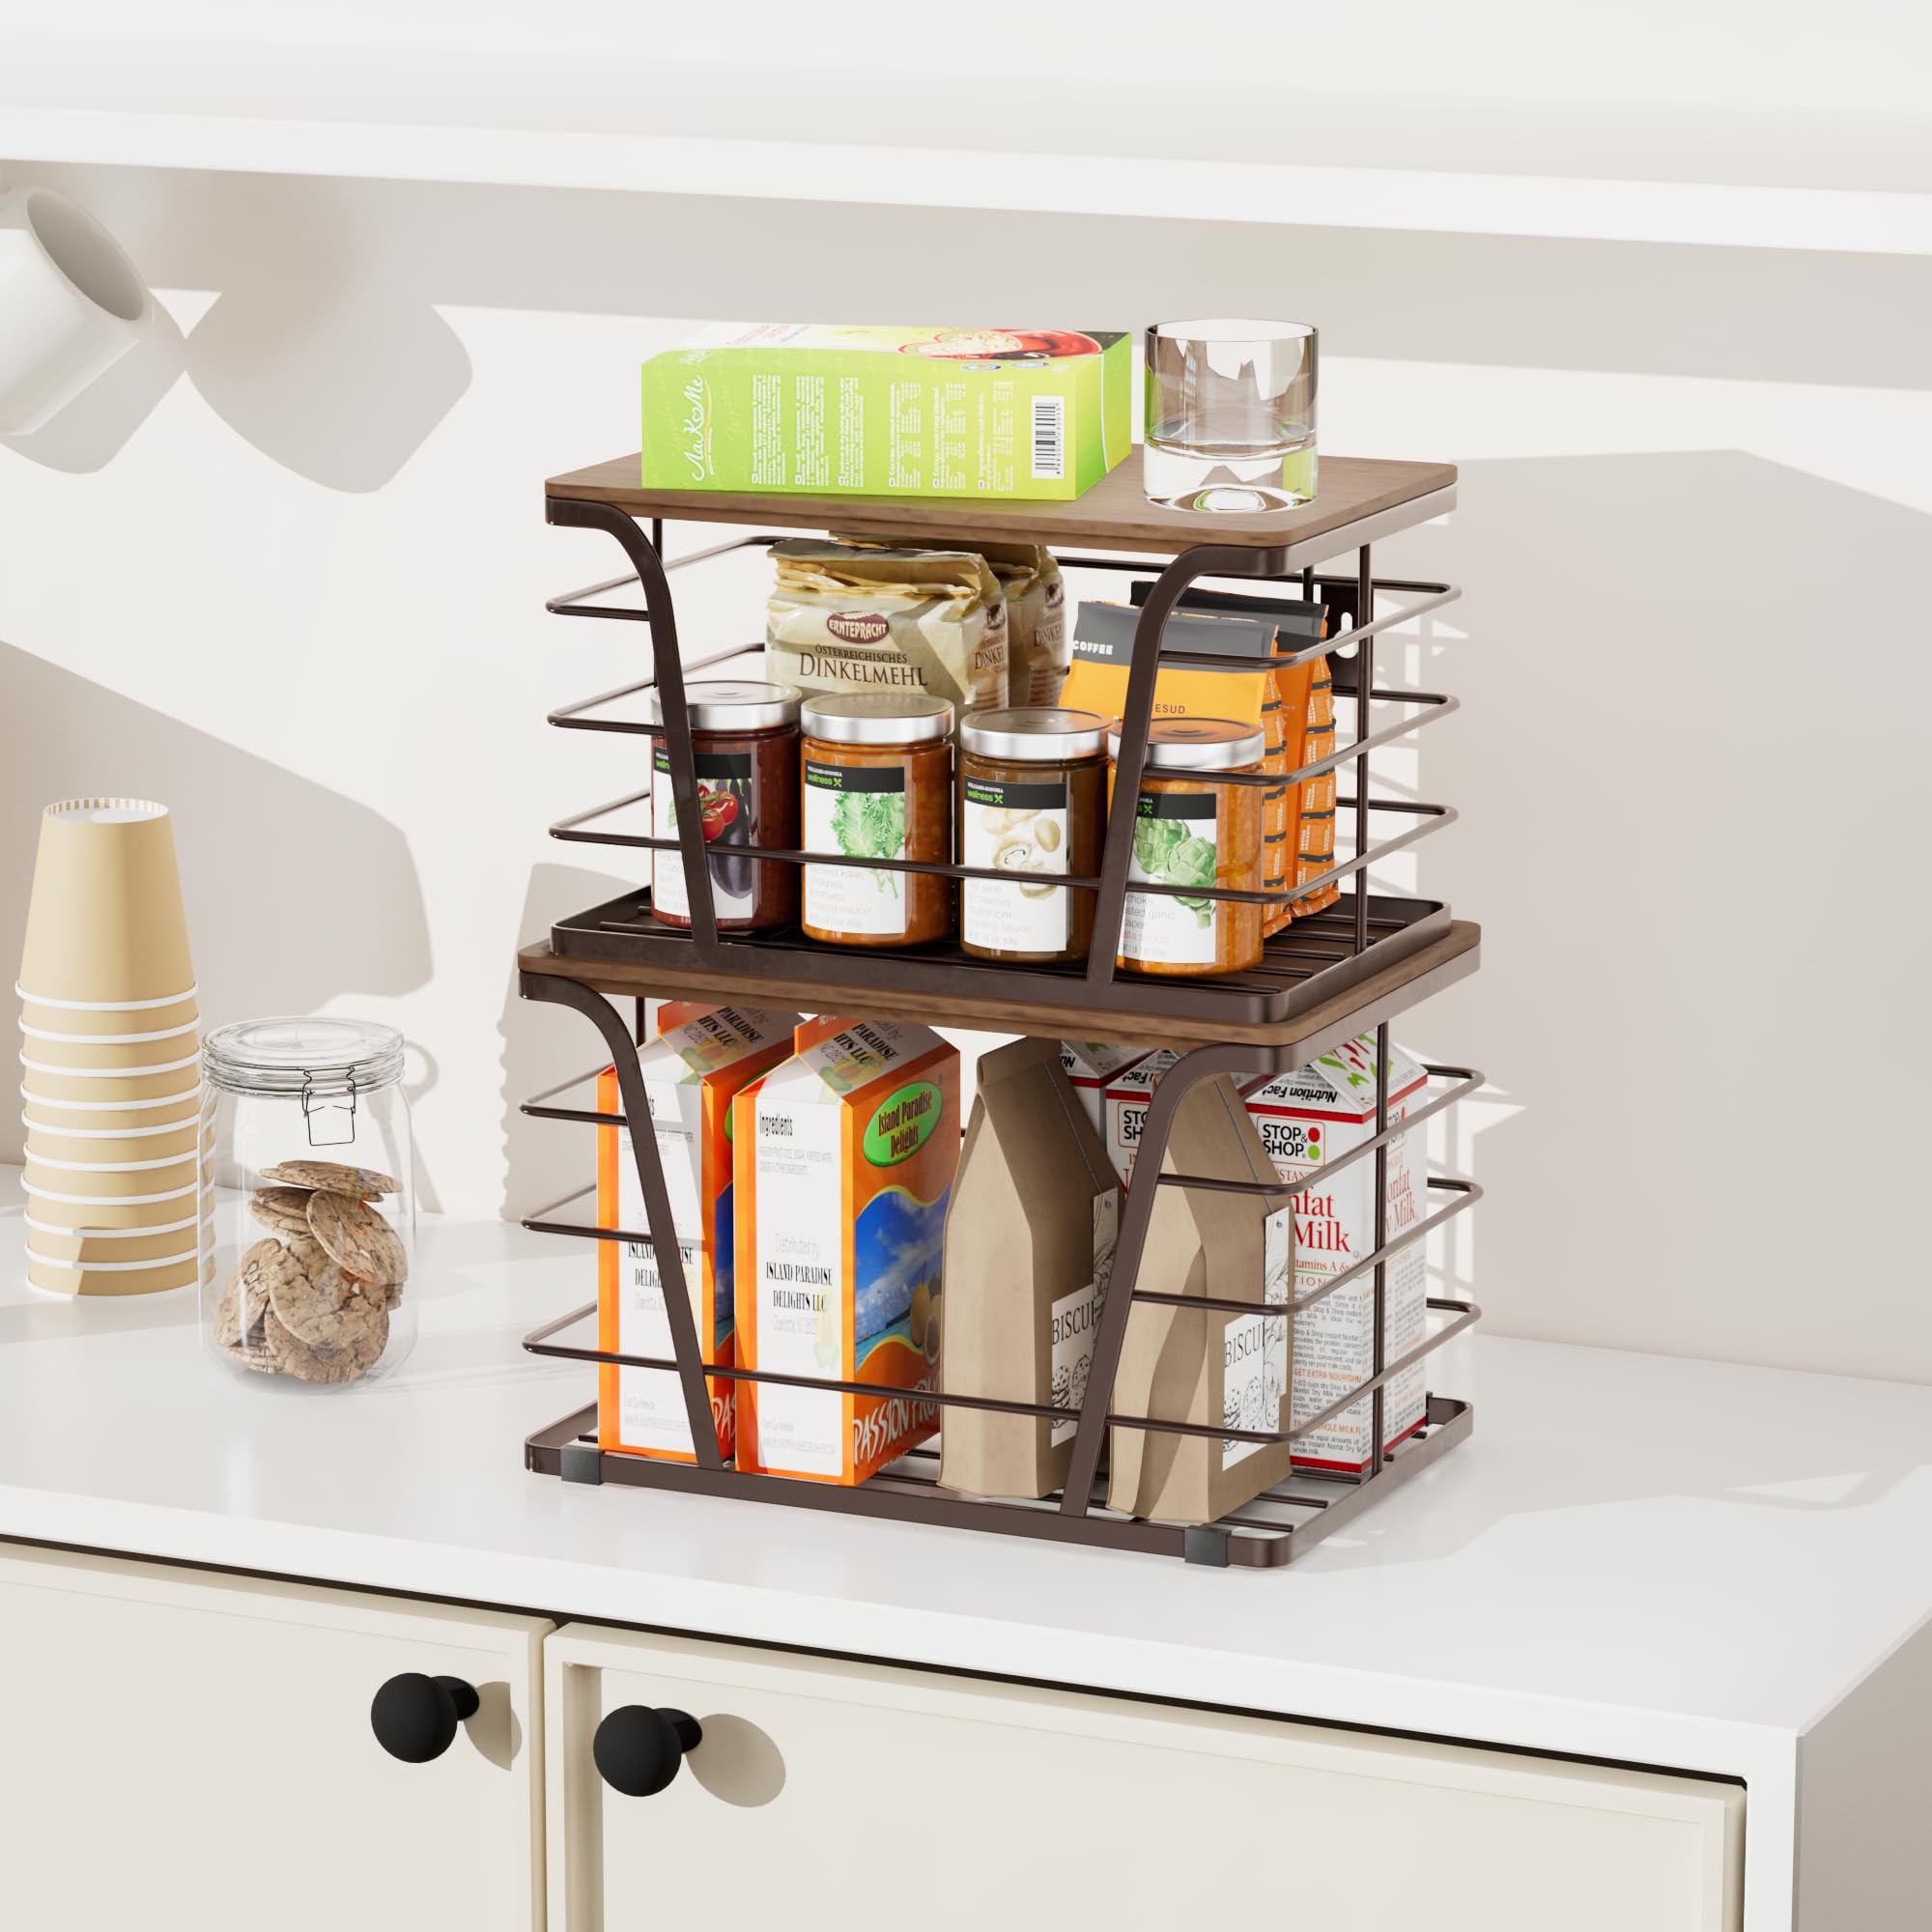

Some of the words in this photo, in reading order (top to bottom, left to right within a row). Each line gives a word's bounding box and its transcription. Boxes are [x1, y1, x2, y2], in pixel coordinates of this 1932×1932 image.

[829, 619, 887, 639] ERNTEPRACHT
[1072, 639, 1113, 655] COFFEE
[799, 652, 927, 686] DINKELMEHL
[716, 1006, 764, 1043] PARADISE
[851, 1023, 899, 1061] PARADISE
[1290, 1087, 1339, 1103] Nutrition
[759, 1112, 793, 1137] Ingredients
[878, 1104, 899, 1137] Island
[902, 1090, 932, 1124] Paradise
[891, 1124, 919, 1158] Delights
[1263, 1123, 1301, 1141] STOP
[1263, 1140, 1304, 1157] SHOP
[1295, 1220, 1350, 1252] Milk
[766, 1262, 793, 1281] ISLAND
[795, 1264, 833, 1286] PARADISE
[773, 1290, 810, 1311] DELIGHTS
[812, 1293, 827, 1314] LLC
[852, 1398, 909, 1465] PASSION
